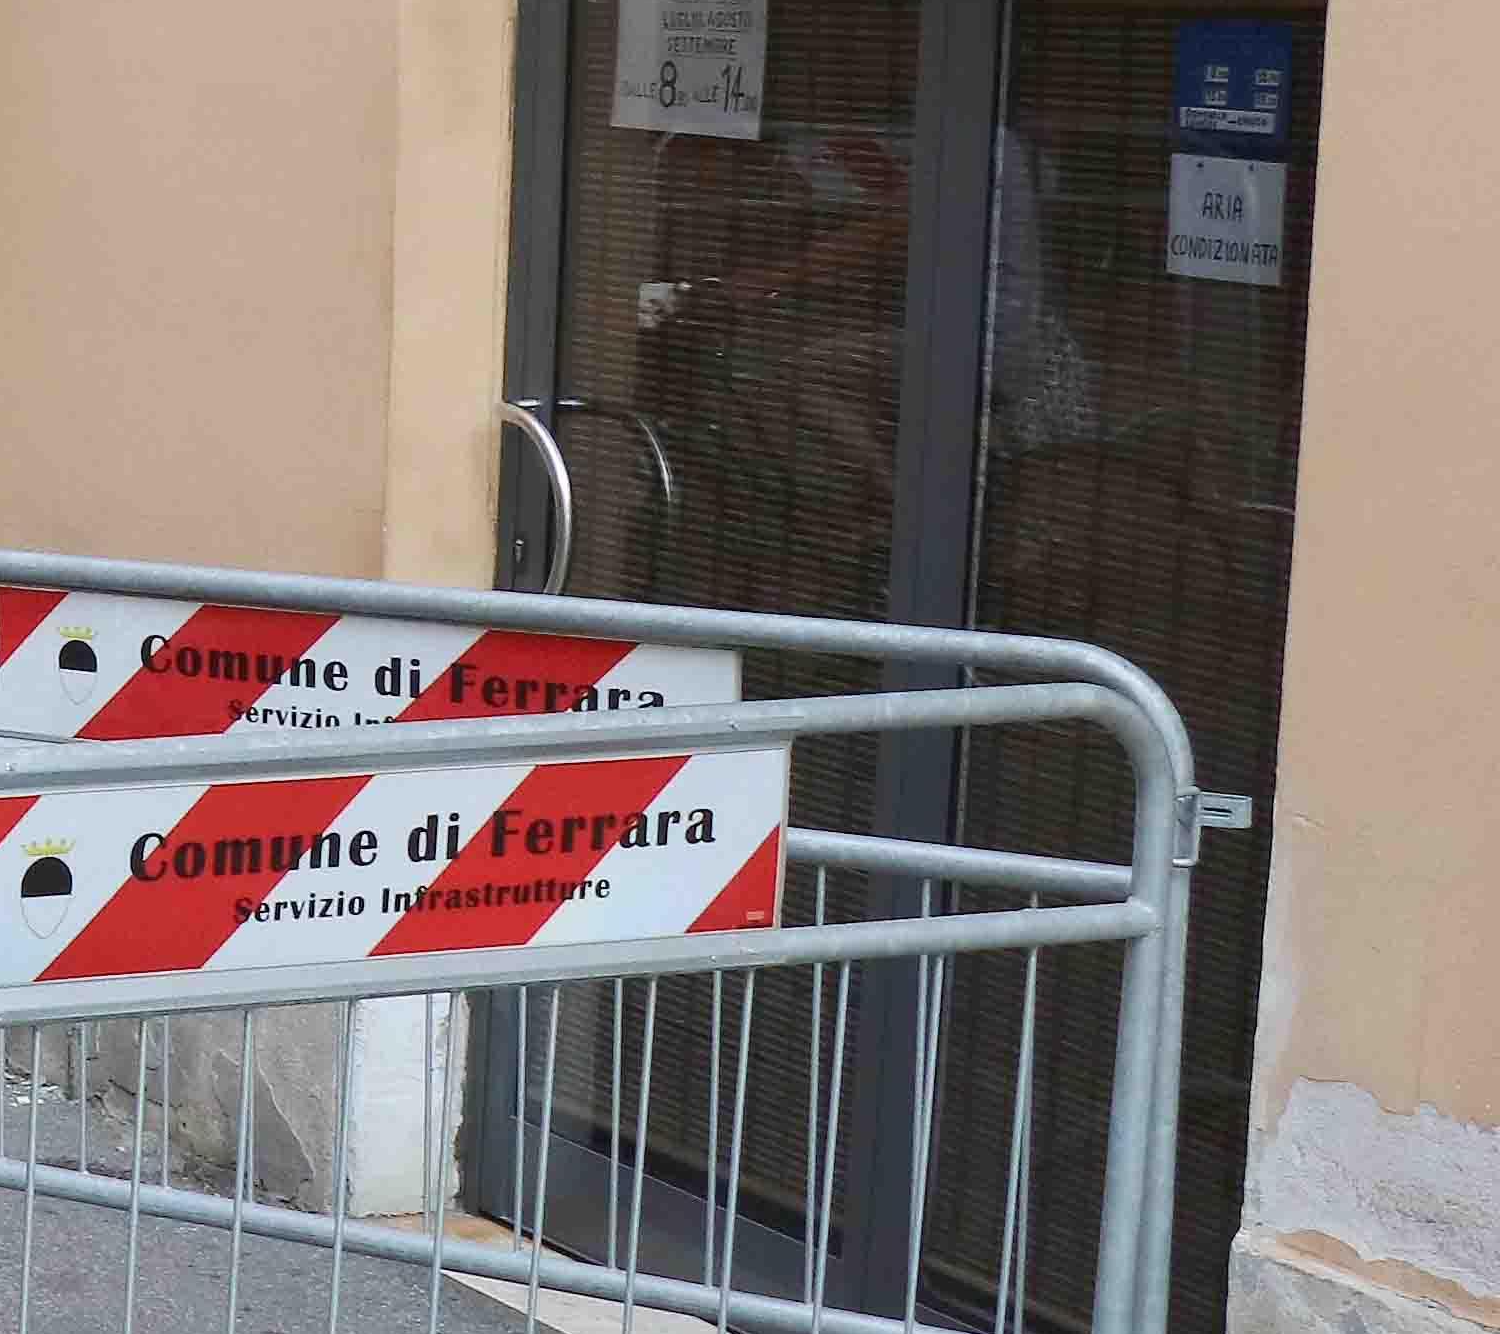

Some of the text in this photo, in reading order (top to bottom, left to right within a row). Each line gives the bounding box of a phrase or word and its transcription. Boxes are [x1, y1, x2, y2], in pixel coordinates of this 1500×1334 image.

[1202, 191, 1244, 223] ARIA
[1170, 233, 1279, 268] CONDIZIONATA
[139, 633, 350, 693] Comune
[373, 654, 422, 700] di
[127, 803, 718, 884] Comune di Ferrara
[232, 872, 613, 927] Servizio Infrastrutture
